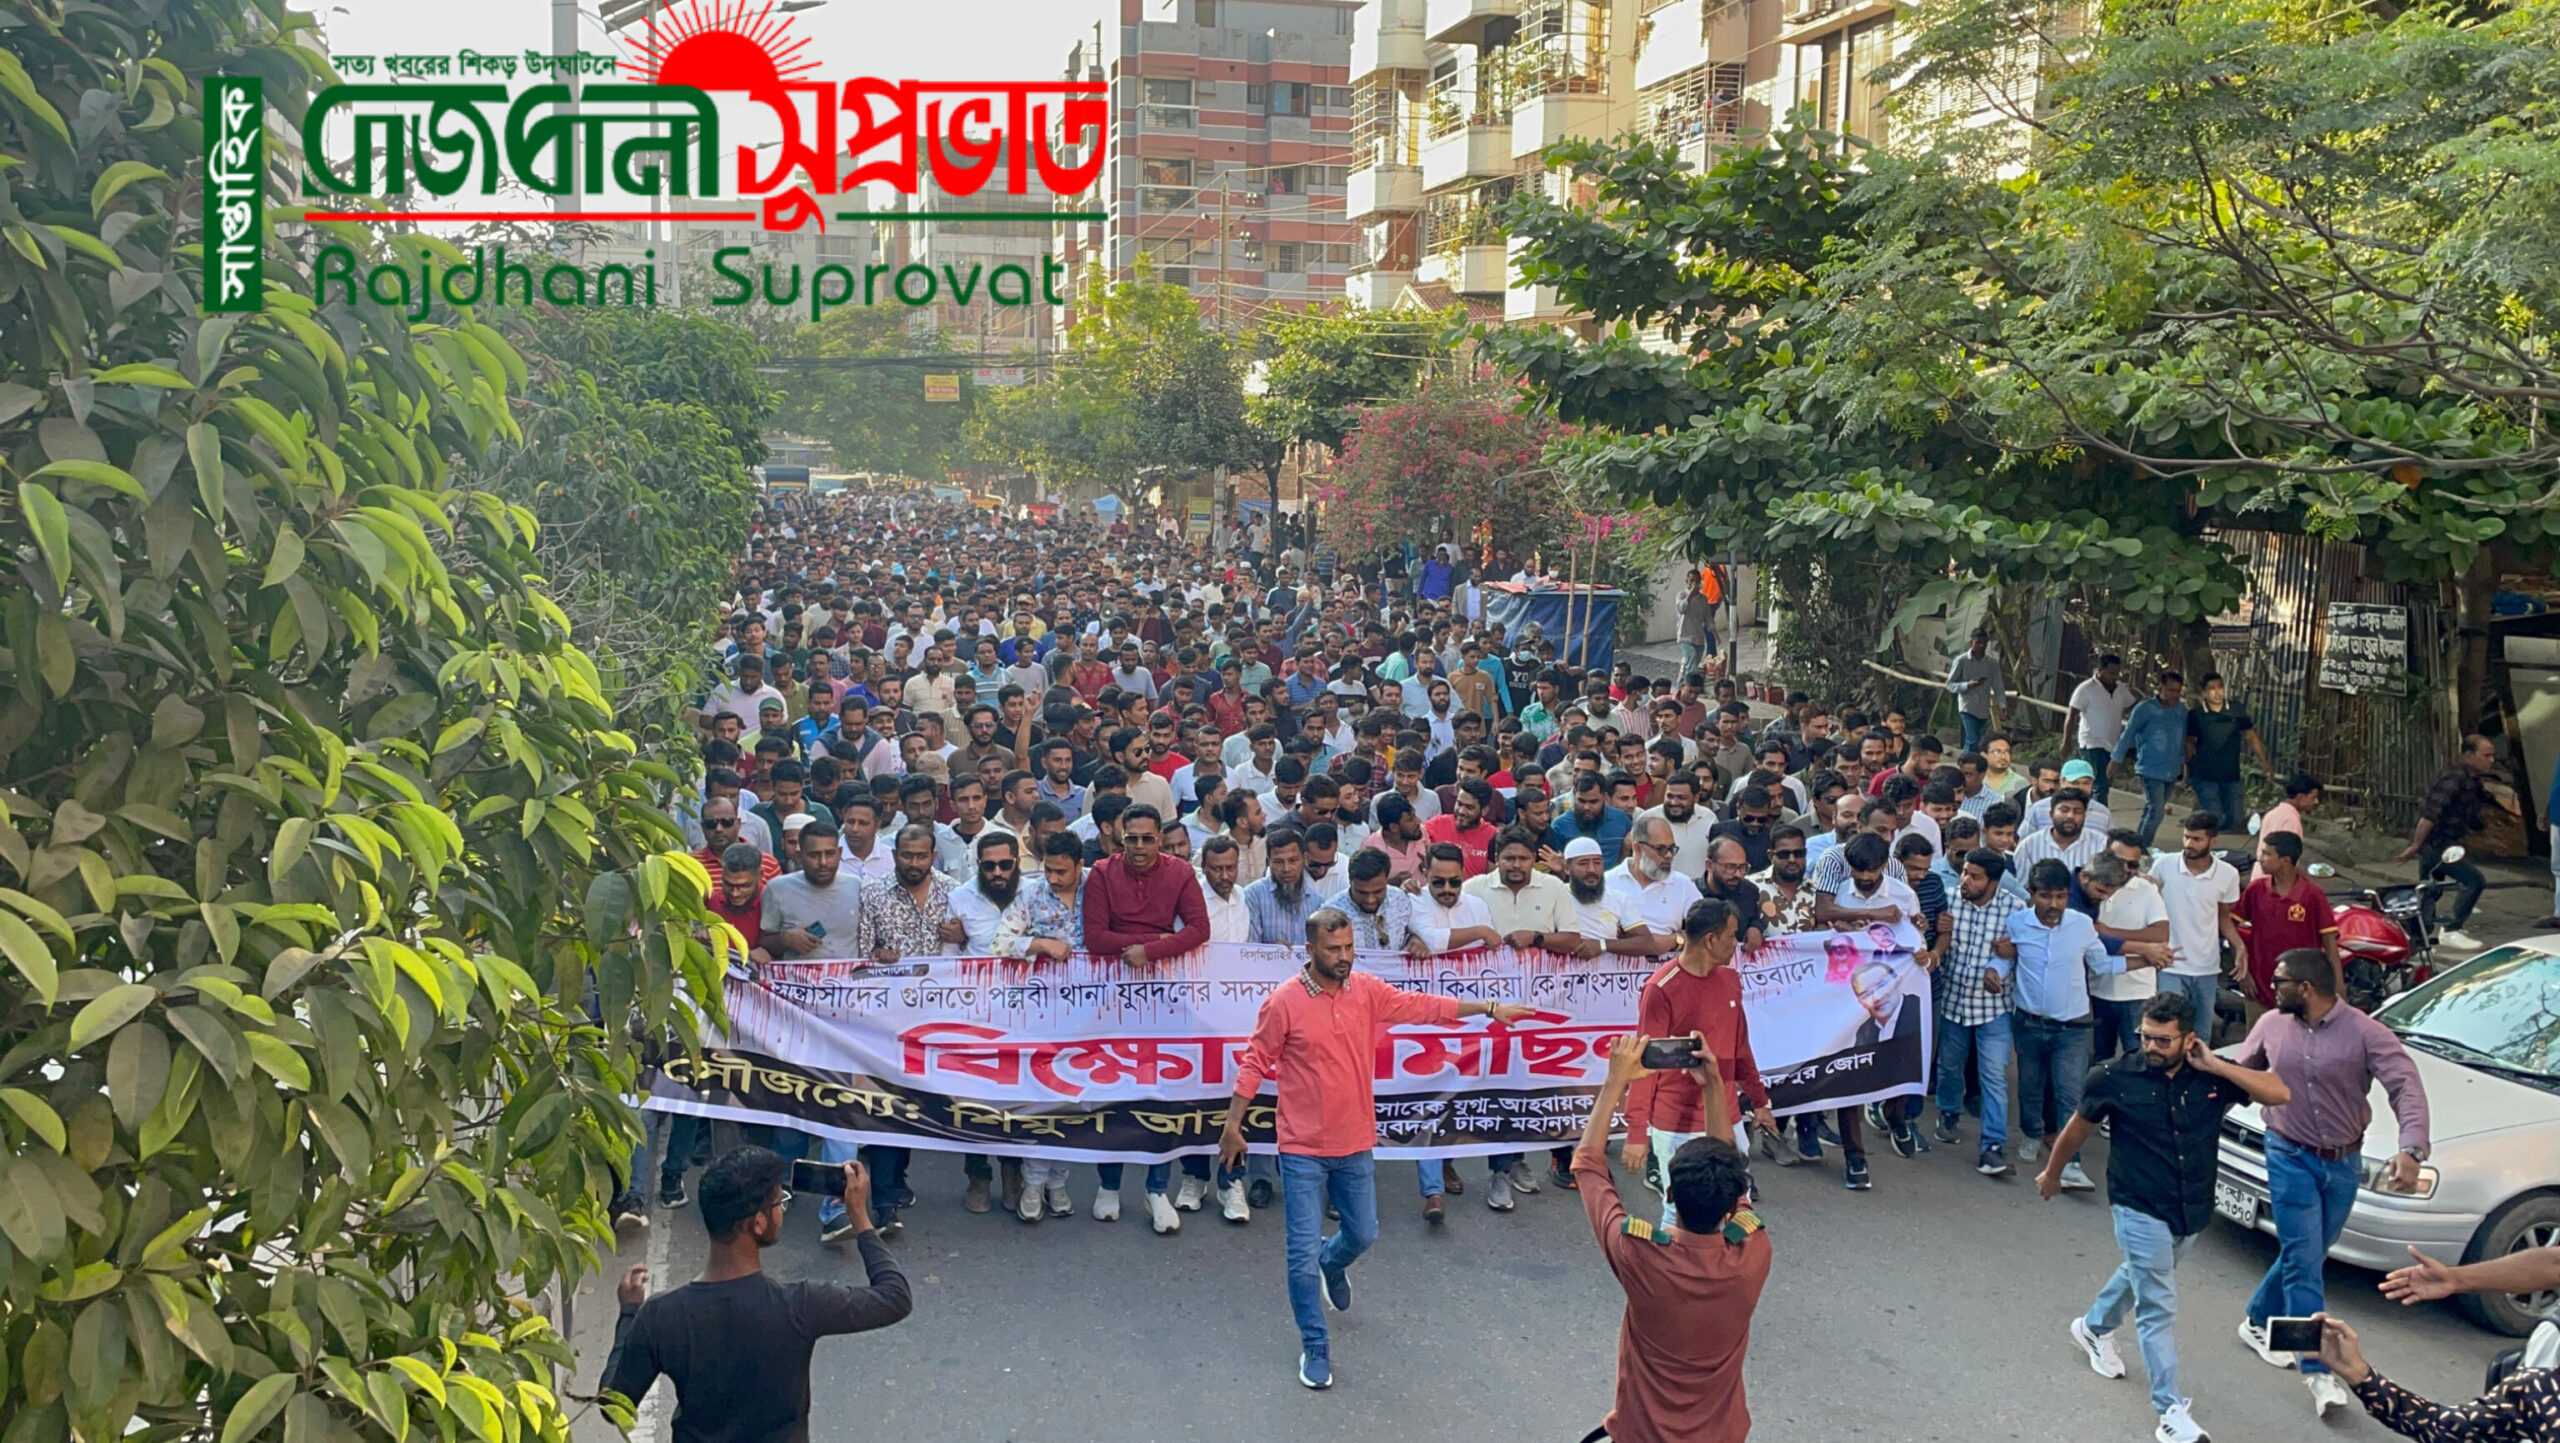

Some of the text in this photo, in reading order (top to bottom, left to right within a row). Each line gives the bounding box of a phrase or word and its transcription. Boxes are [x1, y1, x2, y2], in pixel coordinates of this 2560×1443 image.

[902, 978, 978, 1009] গুলিতে
[989, 977, 1048, 1009] পল্লবী
[1059, 981, 1106, 1007] থানা
[1117, 980, 1210, 1011] যুবদলের
[1220, 980, 1280, 1002] সদস
[1438, 969, 1523, 998] কিবরিয়া
[1532, 974, 1554, 996] কে
[1741, 958, 1816, 991] তিবাদে
[1825, 1052, 1875, 1074] জোন
[943, 1101, 1117, 1138] শিমুল
[1375, 1101, 1448, 1117] সাবেক
[1375, 1118, 1446, 1138] যুবদল,
[1453, 1116, 1505, 1132] ঢাকা
